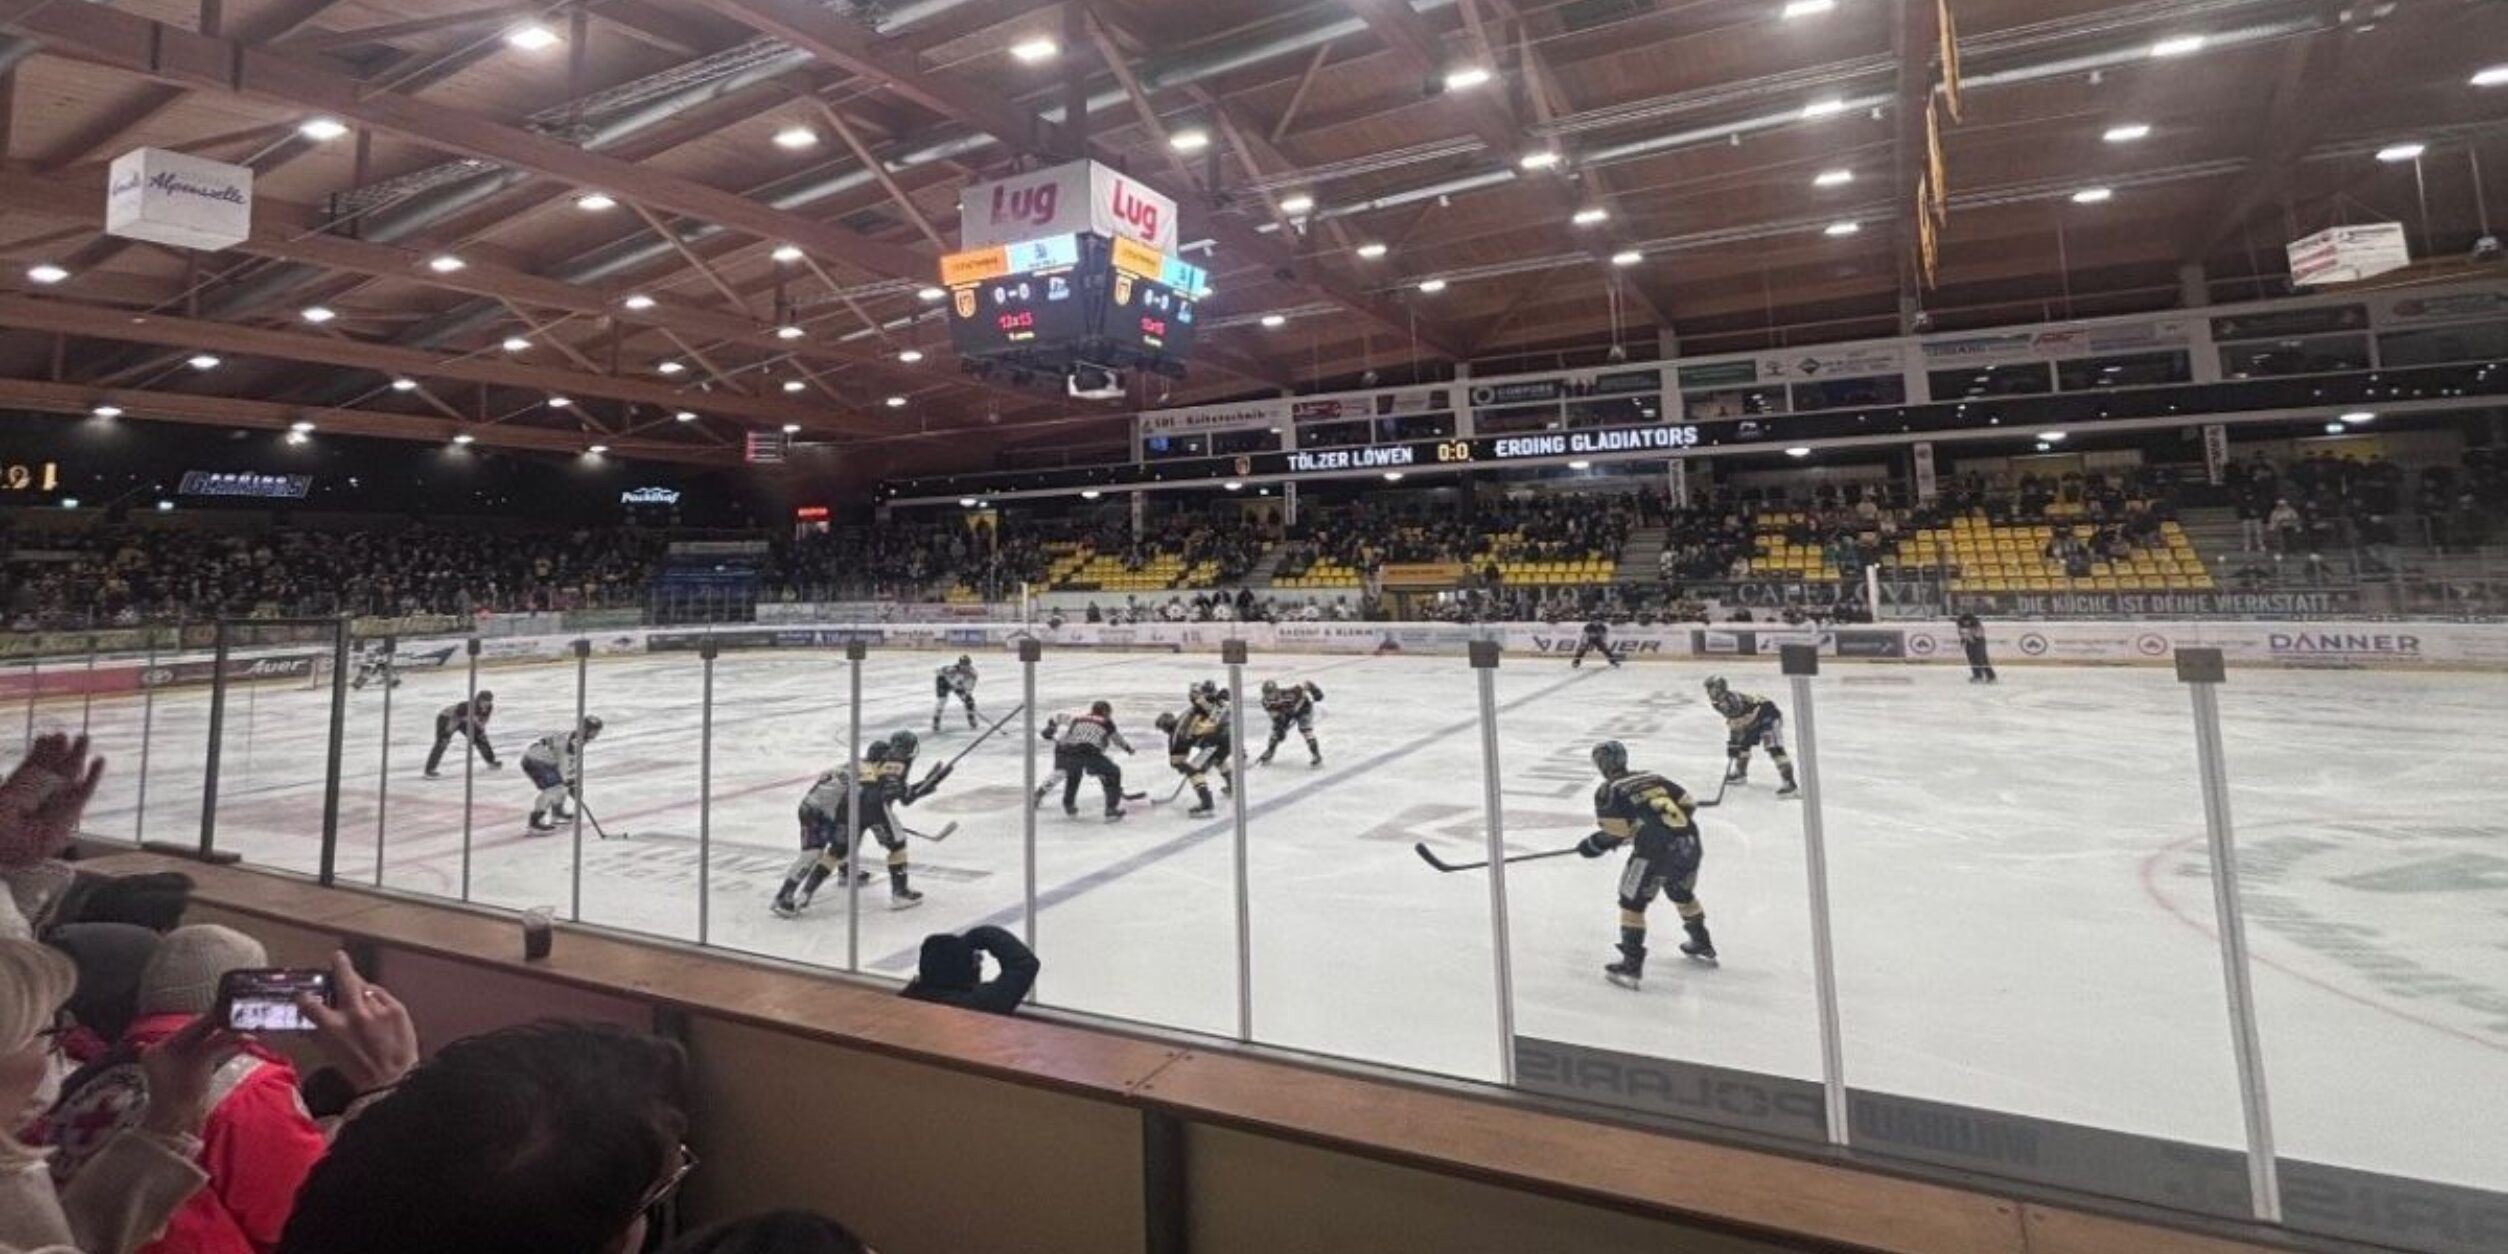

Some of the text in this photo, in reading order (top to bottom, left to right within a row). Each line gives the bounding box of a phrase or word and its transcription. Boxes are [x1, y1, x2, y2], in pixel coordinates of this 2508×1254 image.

[990, 182, 1058, 225] Lug
[1112, 180, 1157, 240] Lug
[1287, 426, 1698, 472] TÖLZER LÖWEN 0:0 ERDING GLADIATORS
[2117, 593, 2146, 612] IST
[1556, 639, 1661, 653] BER
[2269, 633, 2420, 652] DANNER
